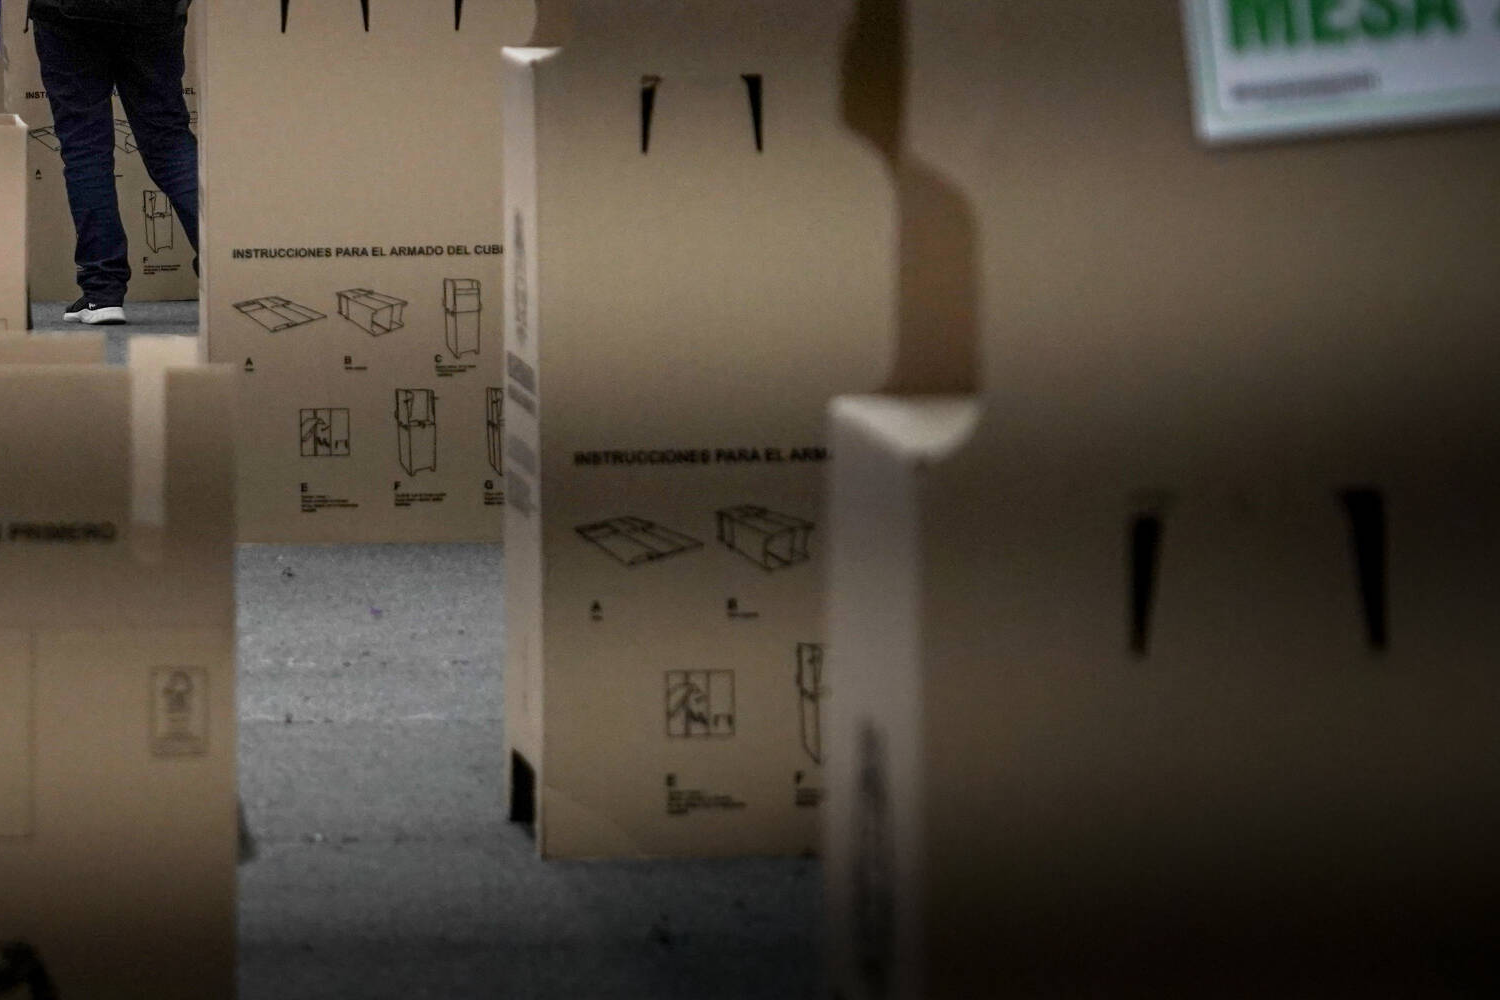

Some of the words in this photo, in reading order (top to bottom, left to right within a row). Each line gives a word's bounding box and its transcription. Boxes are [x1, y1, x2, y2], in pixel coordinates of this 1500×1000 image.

[232, 247, 333, 259] INSTRUCCIONES
[335, 246, 370, 258] PARA
[371, 246, 386, 257] EL
[389, 245, 445, 257] ARMADO
[446, 244, 471, 256] DEL
[574, 449, 711, 466] INSTRUCCIONES
[715, 449, 762, 464] PARA
[763, 447, 785, 464] EL
